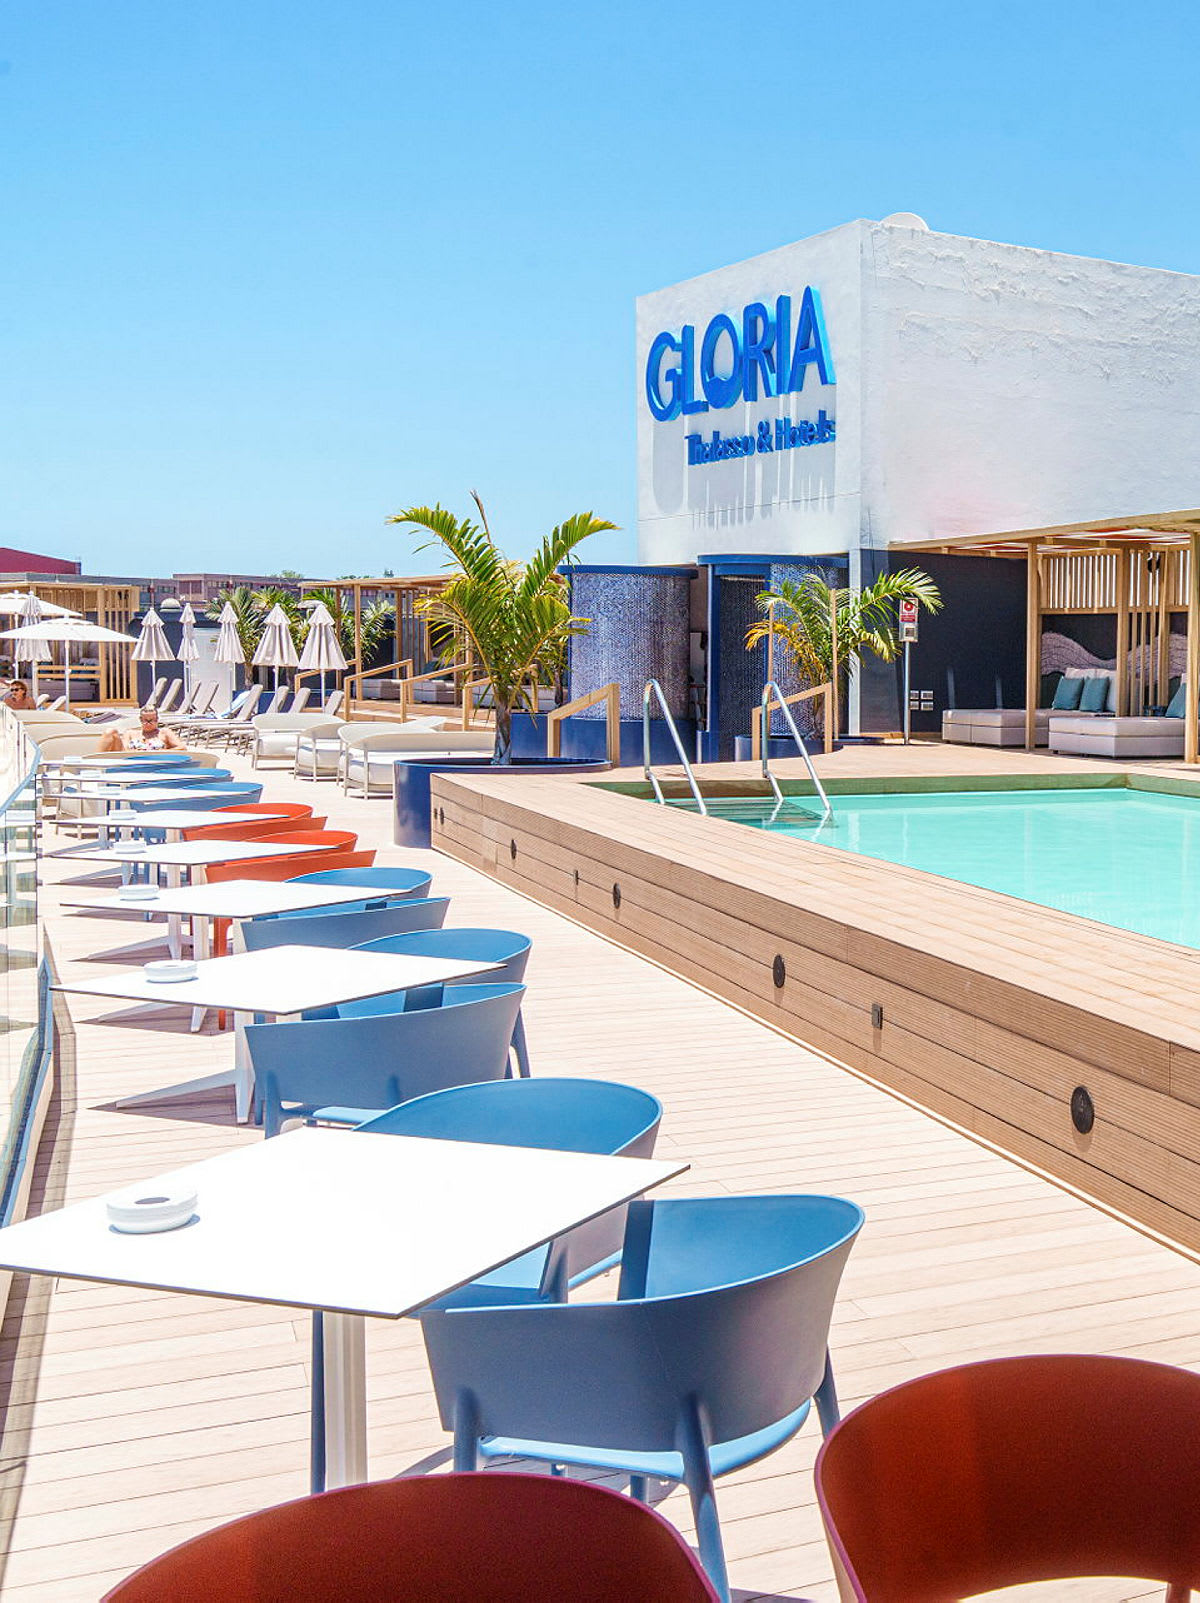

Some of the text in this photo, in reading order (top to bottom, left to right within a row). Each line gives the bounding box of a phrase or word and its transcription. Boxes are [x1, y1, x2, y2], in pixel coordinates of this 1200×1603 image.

[646, 285, 836, 422] GLORIA
[757, 420, 774, 453] &
[775, 409, 836, 451] Hotels
